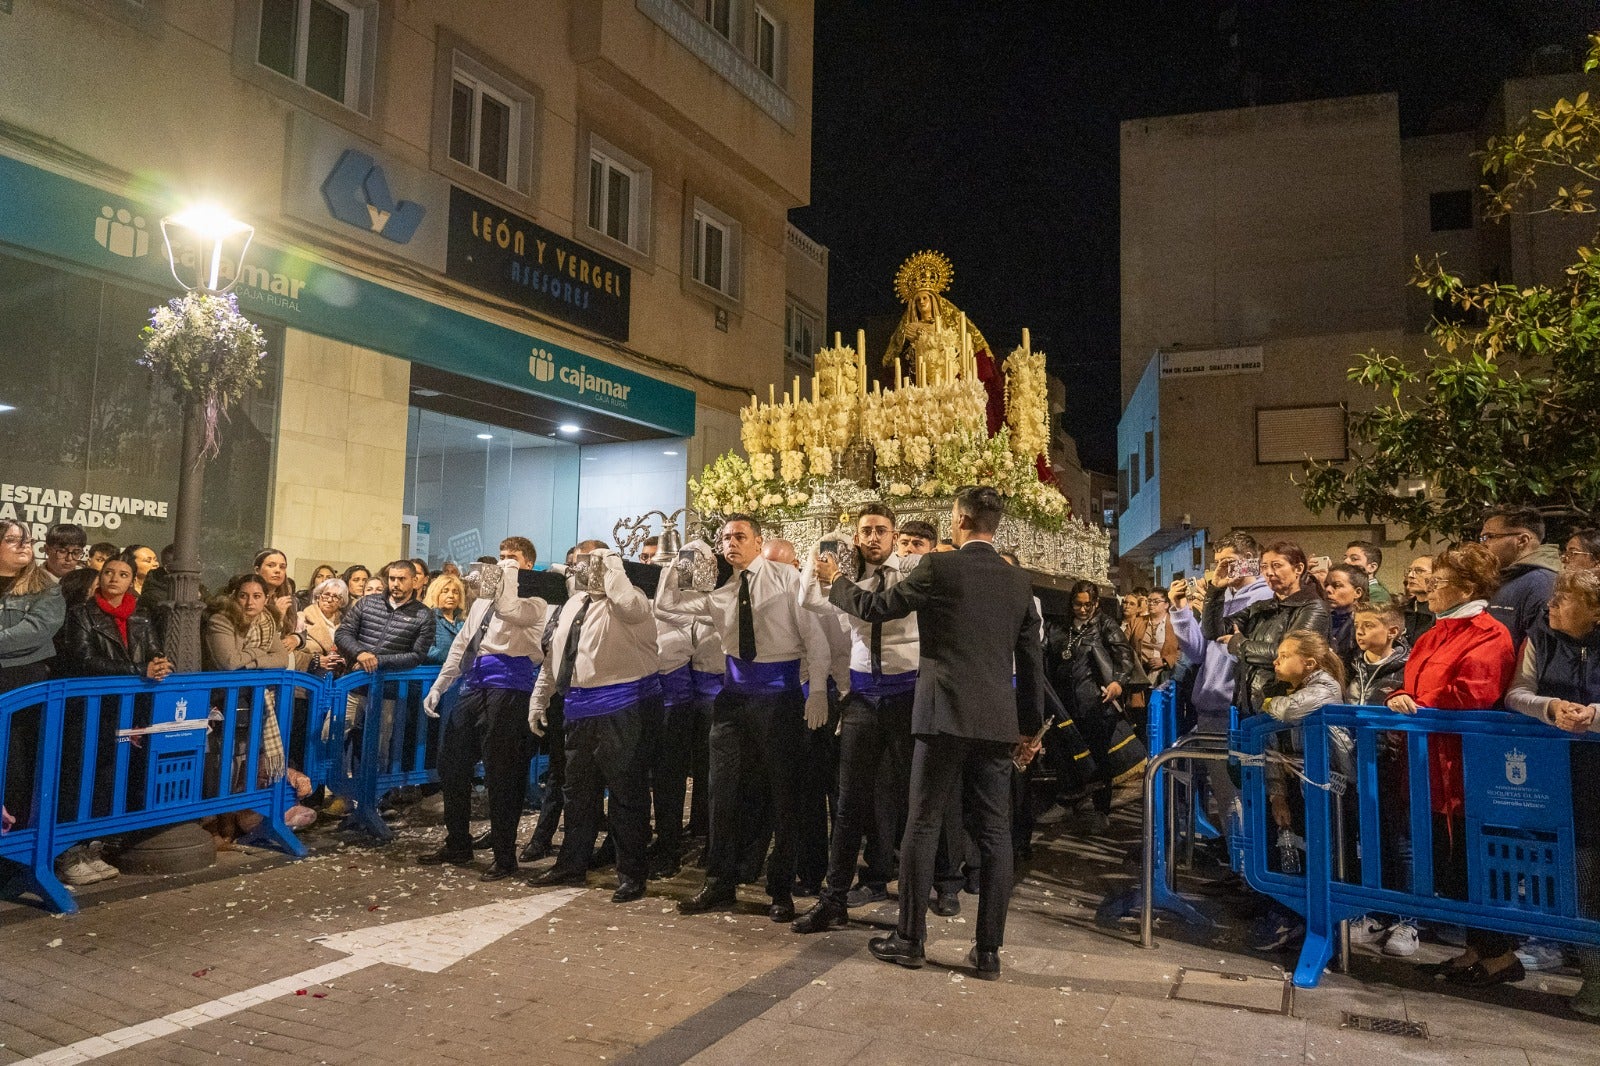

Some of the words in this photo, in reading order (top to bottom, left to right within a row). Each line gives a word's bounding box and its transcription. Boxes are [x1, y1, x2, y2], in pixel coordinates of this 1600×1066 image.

[472, 210, 525, 256] LEÓN
[536, 239, 547, 265] Y
[556, 248, 621, 298] VERGEL
[235, 285, 264, 303] CAJA
[267, 294, 301, 313] RURAL
[511, 261, 589, 310] ASESORES
[559, 365, 631, 401] cajamar
[0, 502, 18, 520] A
[23, 504, 54, 524] TU
[60, 507, 122, 530] LADO
[1, 484, 74, 508] ESTAR
[79, 493, 169, 518] SIEMPRE
